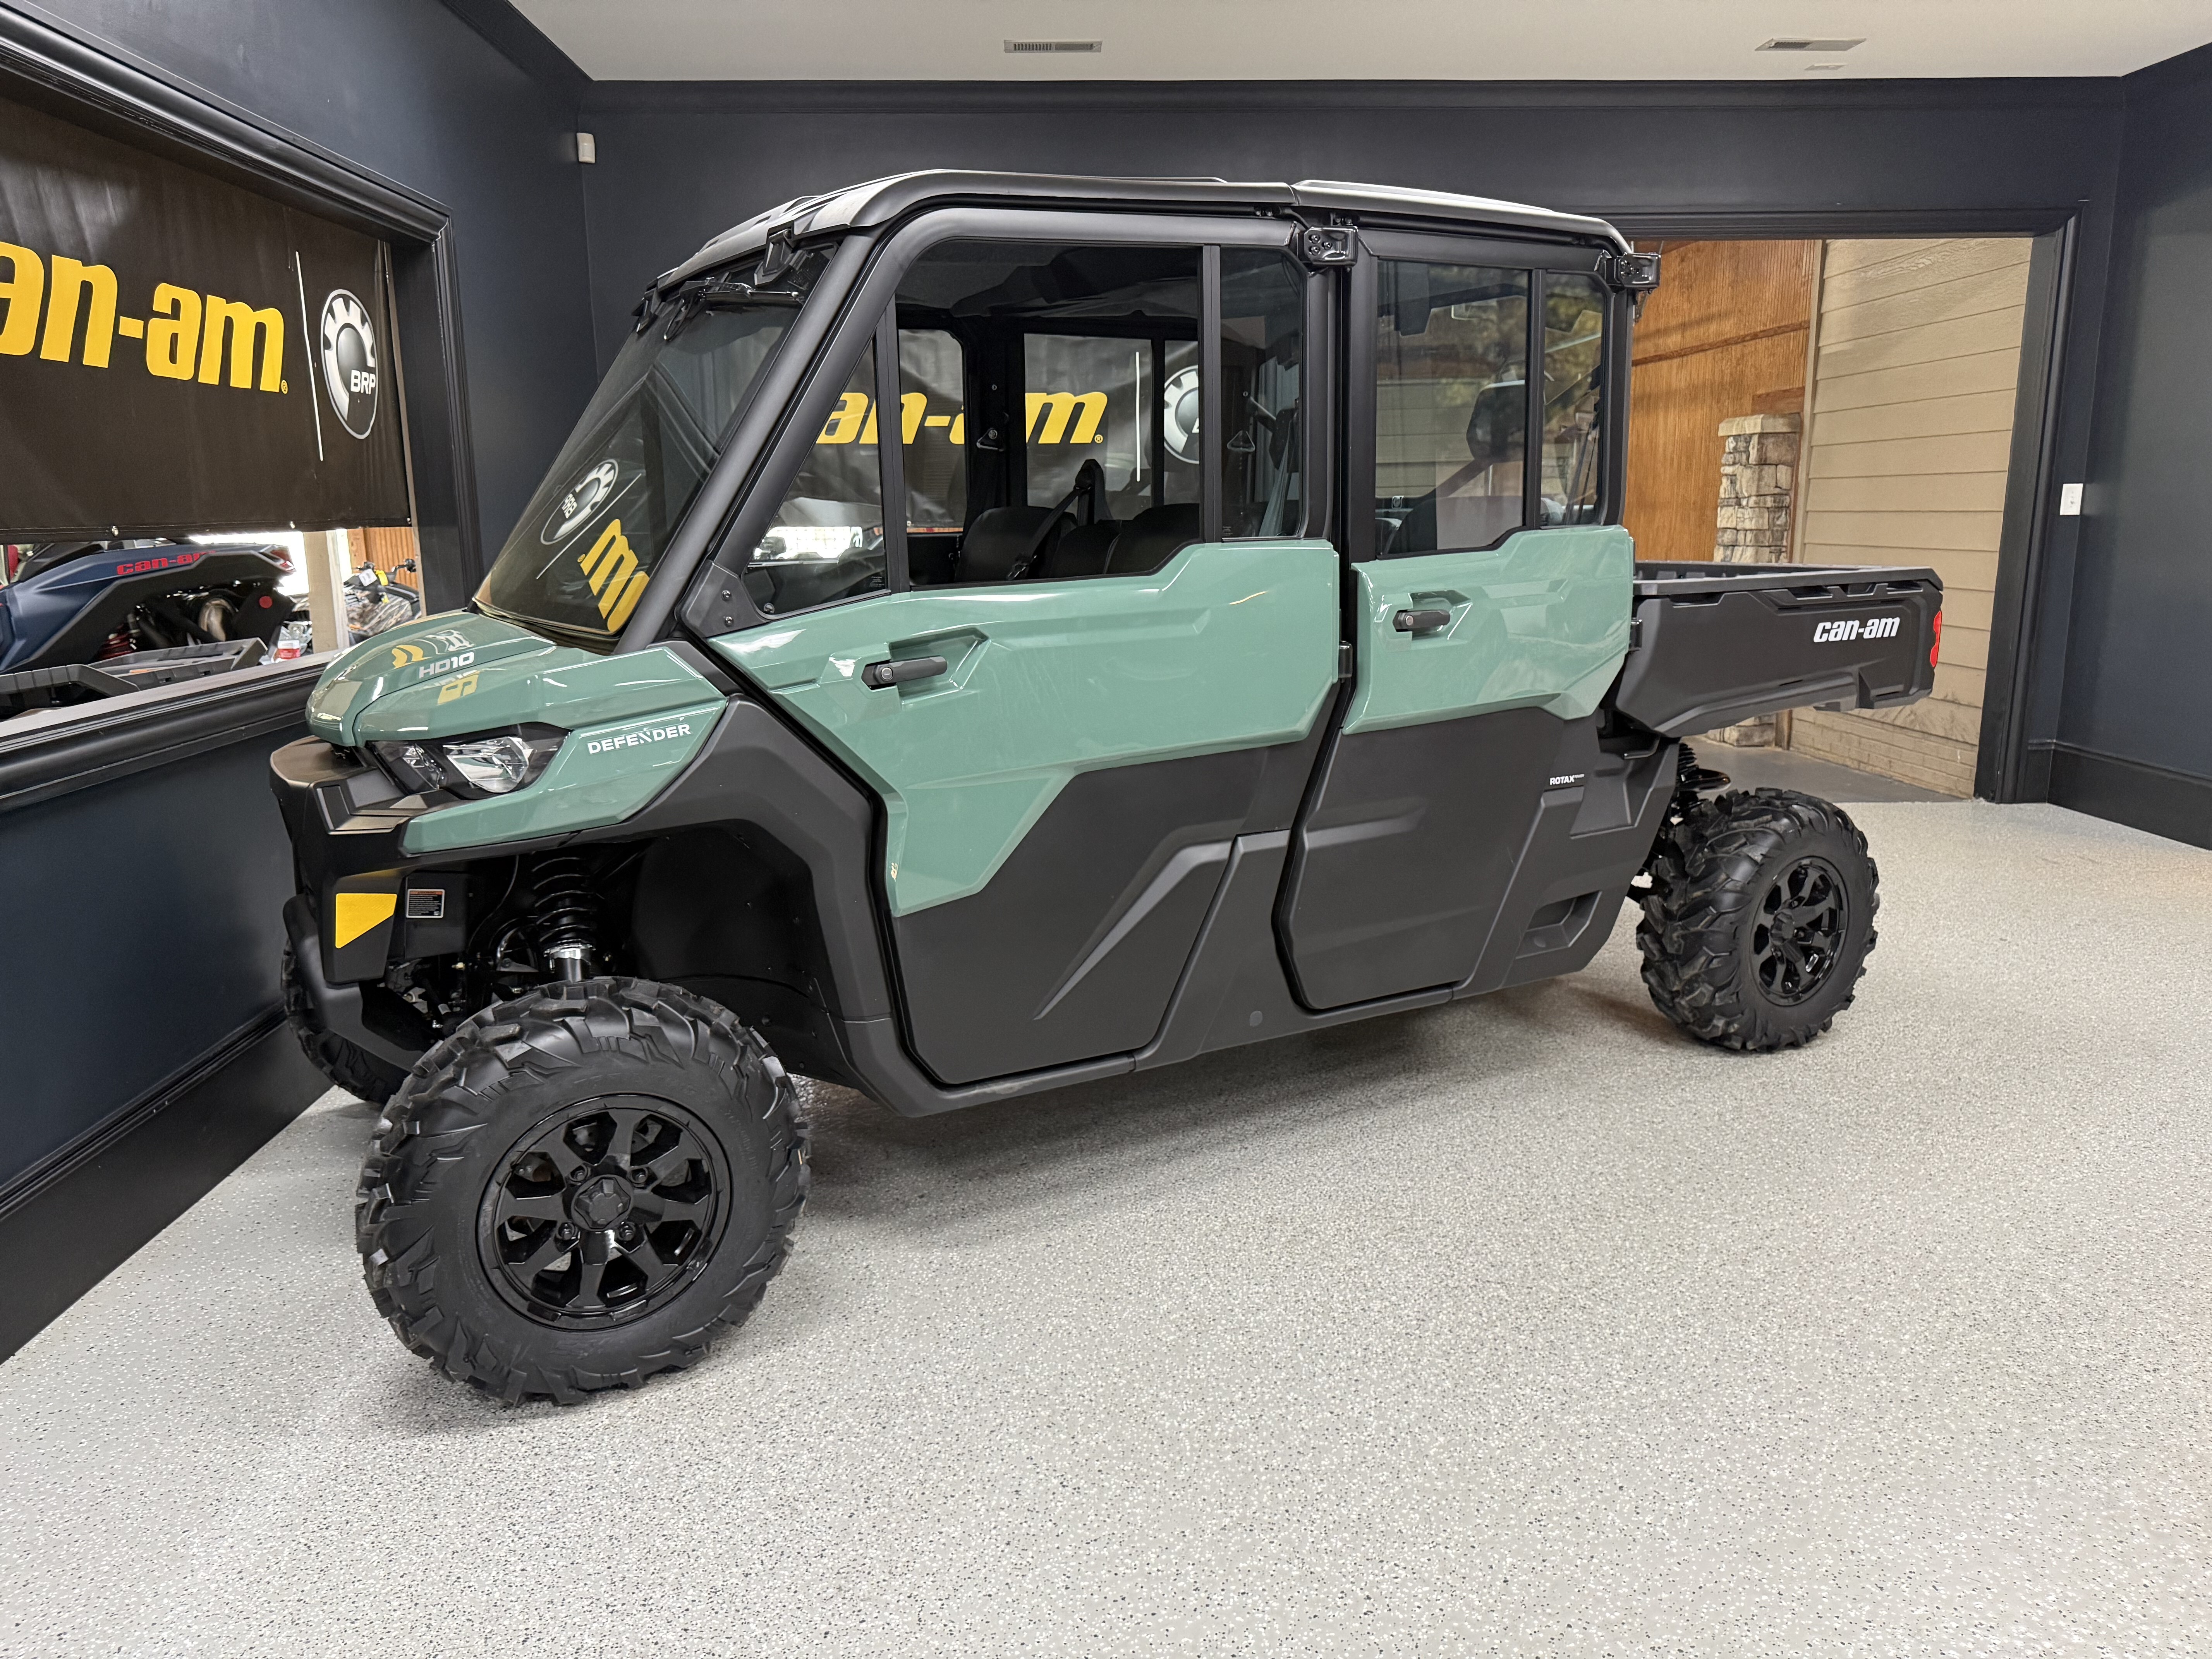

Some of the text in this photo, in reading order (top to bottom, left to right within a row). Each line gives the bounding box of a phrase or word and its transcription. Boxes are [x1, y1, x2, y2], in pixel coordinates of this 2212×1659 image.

[350, 369, 376, 394] BRP
[1814, 617, 1900, 642] can-am
[419, 652, 474, 678] HD10
[587, 724, 691, 754] DEFENDER
[1550, 775, 1575, 785] ROTAX
